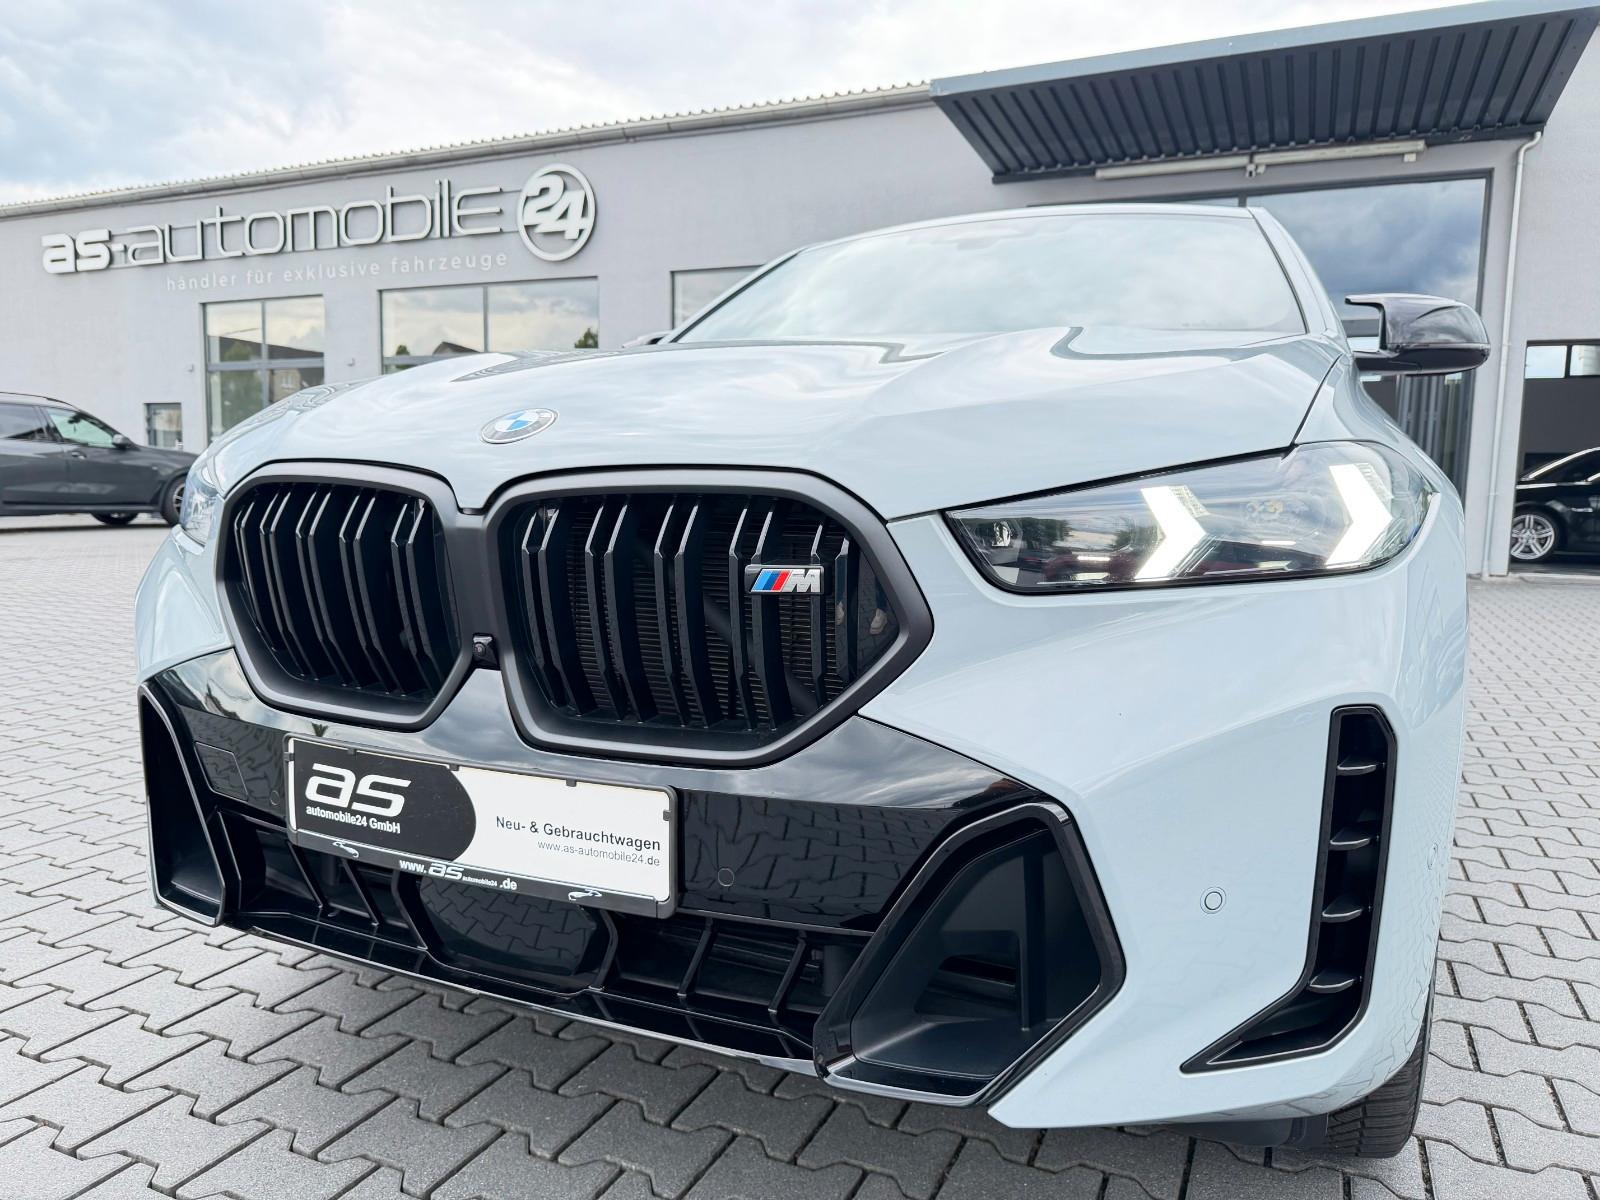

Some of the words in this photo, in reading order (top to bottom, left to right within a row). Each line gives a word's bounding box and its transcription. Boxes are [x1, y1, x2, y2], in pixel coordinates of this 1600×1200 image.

[522, 173, 589, 241] 24
[166, 271, 237, 292] händler
[246, 268, 273, 285] für
[283, 261, 381, 283] exklusive
[391, 252, 508, 273] fahrzeuge
[304, 762, 412, 818] as
[305, 805, 368, 827] automobile24
[368, 817, 401, 835] GmbH
[496, 815, 526, 831] Neu-
[529, 820, 540, 835] &
[543, 822, 661, 851] Gebrauchtwagen
[537, 840, 661, 867] www.as-automobile24.de
